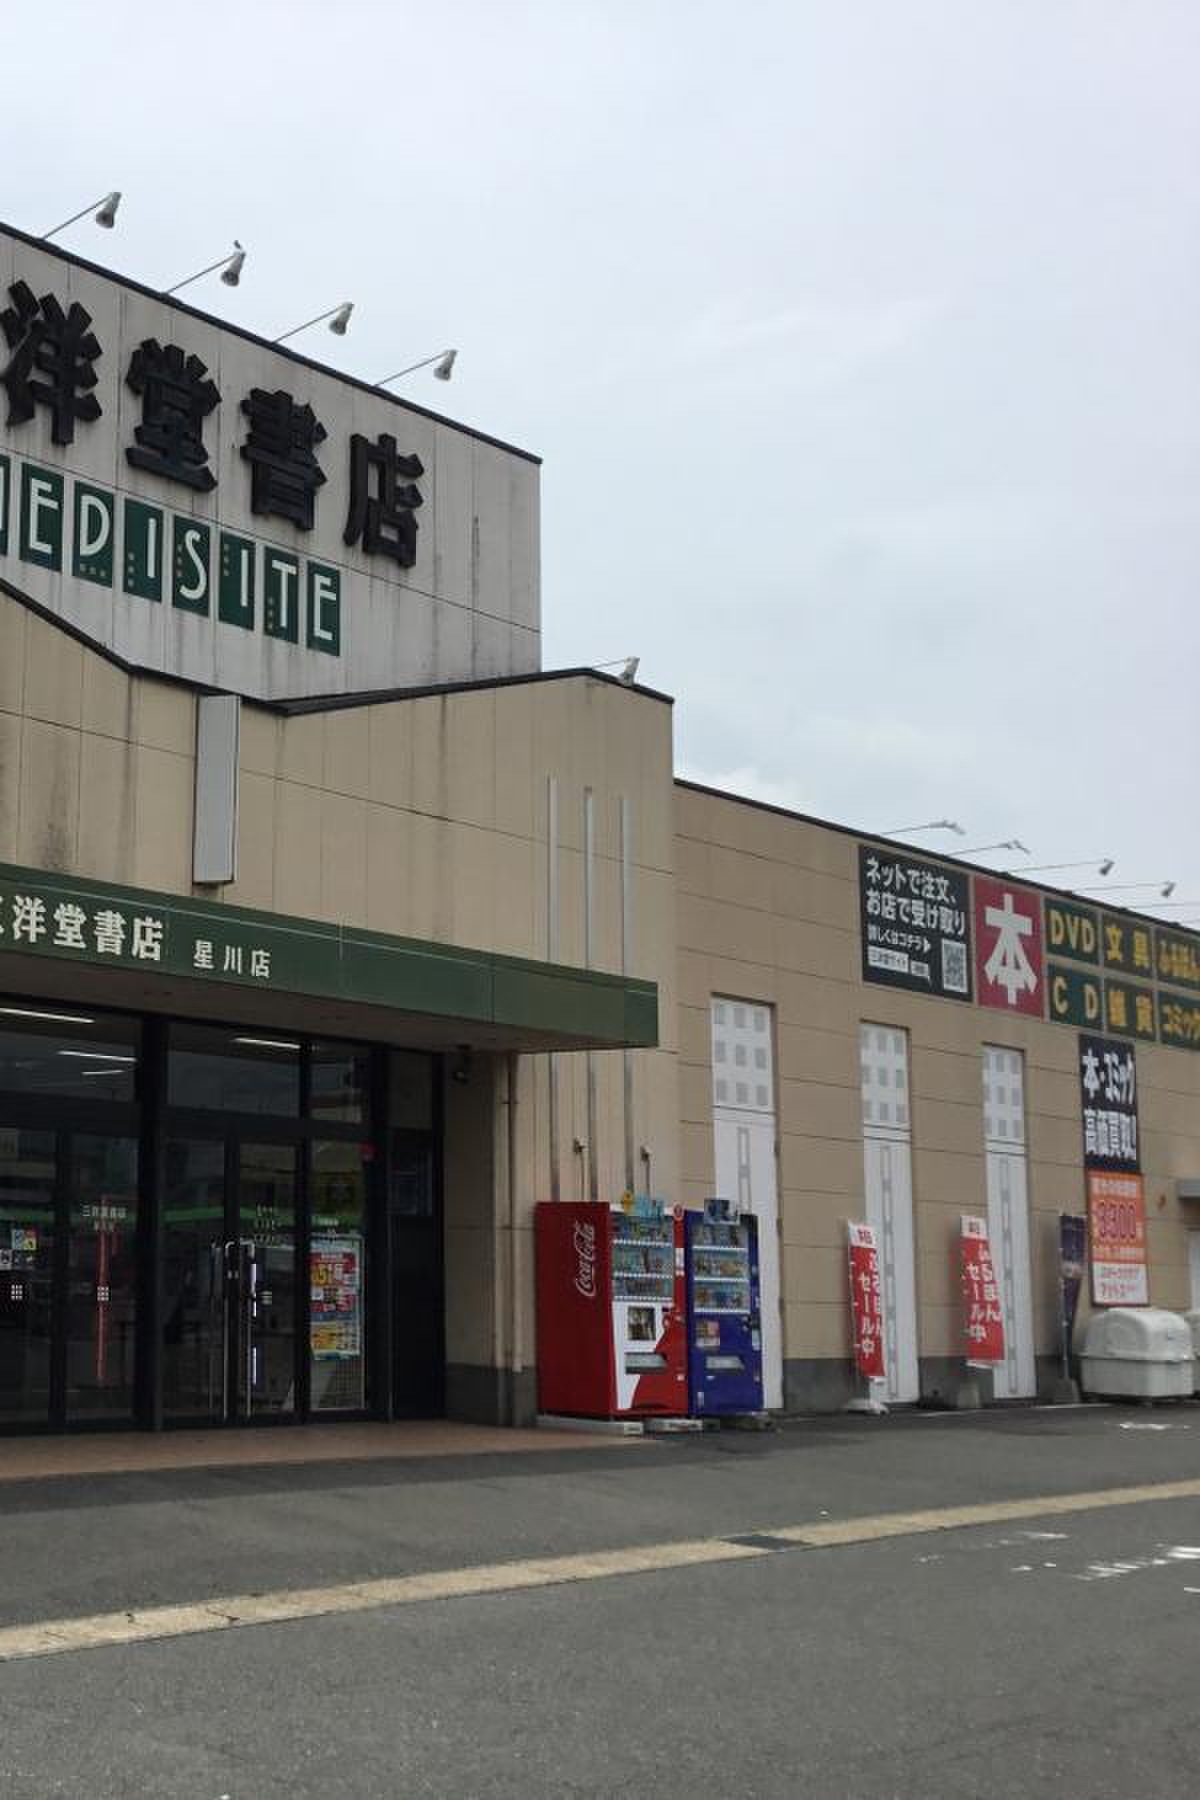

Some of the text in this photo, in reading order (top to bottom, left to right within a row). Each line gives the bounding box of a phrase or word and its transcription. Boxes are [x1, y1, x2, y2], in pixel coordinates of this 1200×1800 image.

[866, 887, 966, 937] お店で受け取り
[1049, 908, 1096, 953] DVD
[192, 938, 272, 979] 星川店
[984, 893, 1038, 1005] 本
[1053, 975, 1099, 1020] CD
[574, 1215, 597, 1298] Coca-Cola
